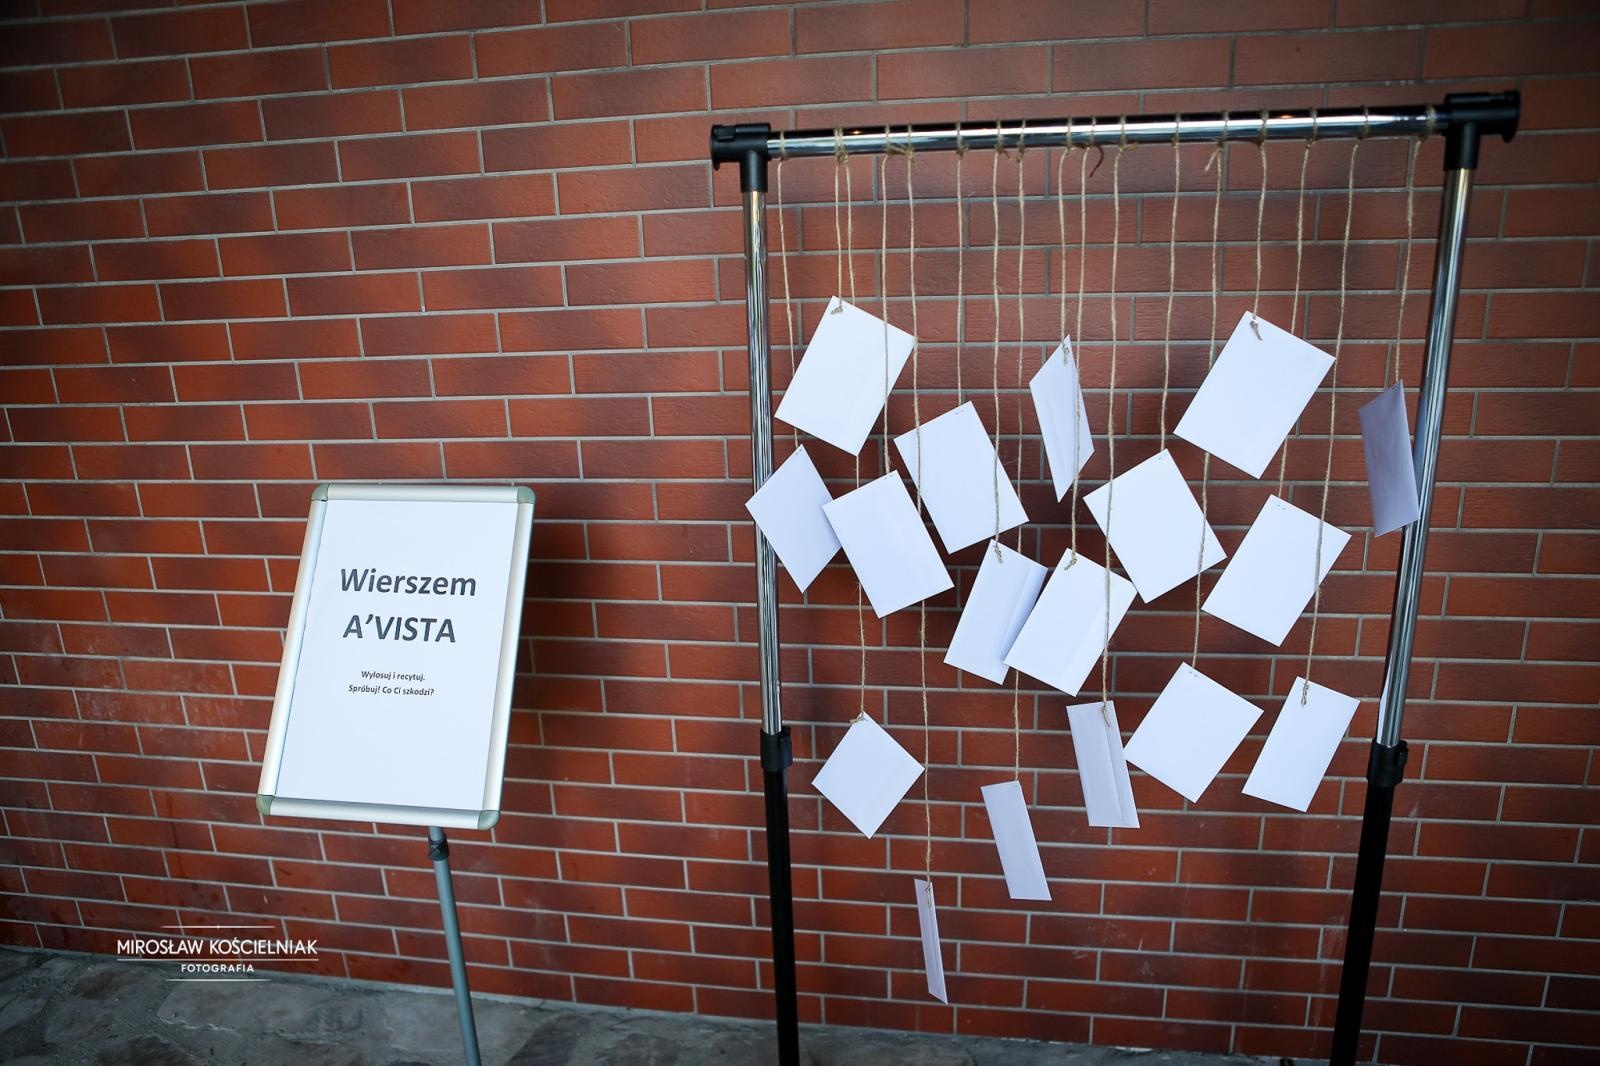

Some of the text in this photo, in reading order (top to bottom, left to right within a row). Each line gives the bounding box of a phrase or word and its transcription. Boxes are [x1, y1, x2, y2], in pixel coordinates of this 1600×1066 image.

[341, 568, 476, 596] Wierszem
[343, 614, 456, 642] A’VISTA
[361, 670, 391, 681] Wylosuj
[397, 673, 426, 683] recytuj.
[348, 684, 381, 695] Spróbuj!
[394, 686, 402, 694] Ci
[402, 687, 434, 696] szkodzi?
